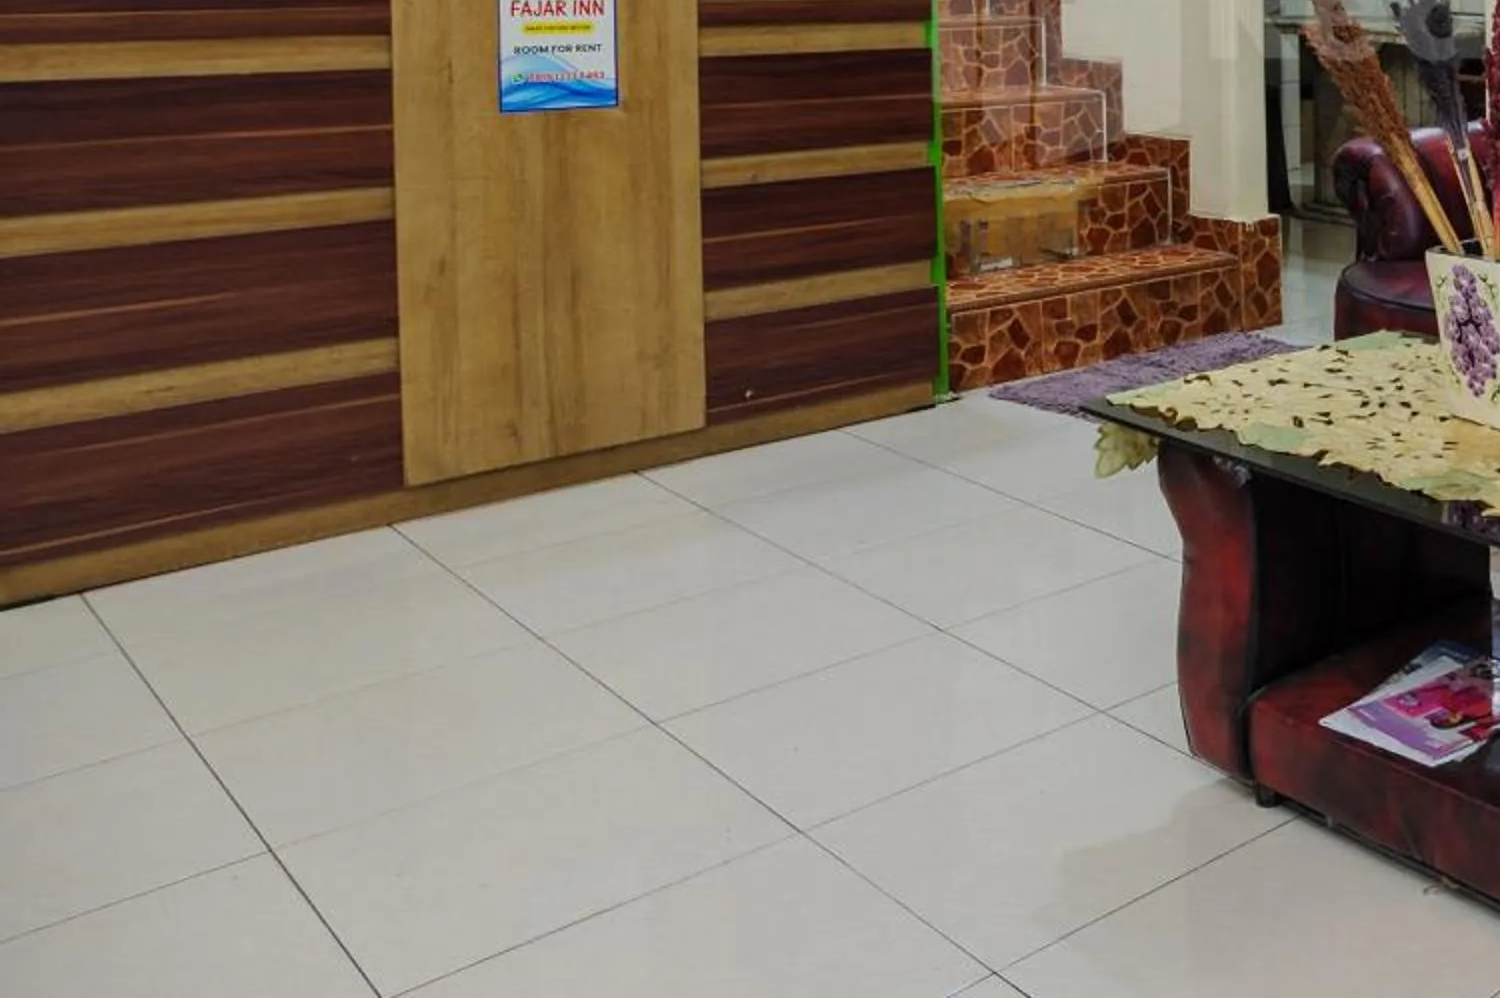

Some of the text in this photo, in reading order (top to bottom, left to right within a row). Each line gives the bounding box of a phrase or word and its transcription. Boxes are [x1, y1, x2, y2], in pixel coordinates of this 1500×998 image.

[511, 0, 605, 16] FAJAR INN
[513, 43, 603, 54] ROOM FOR RENT
